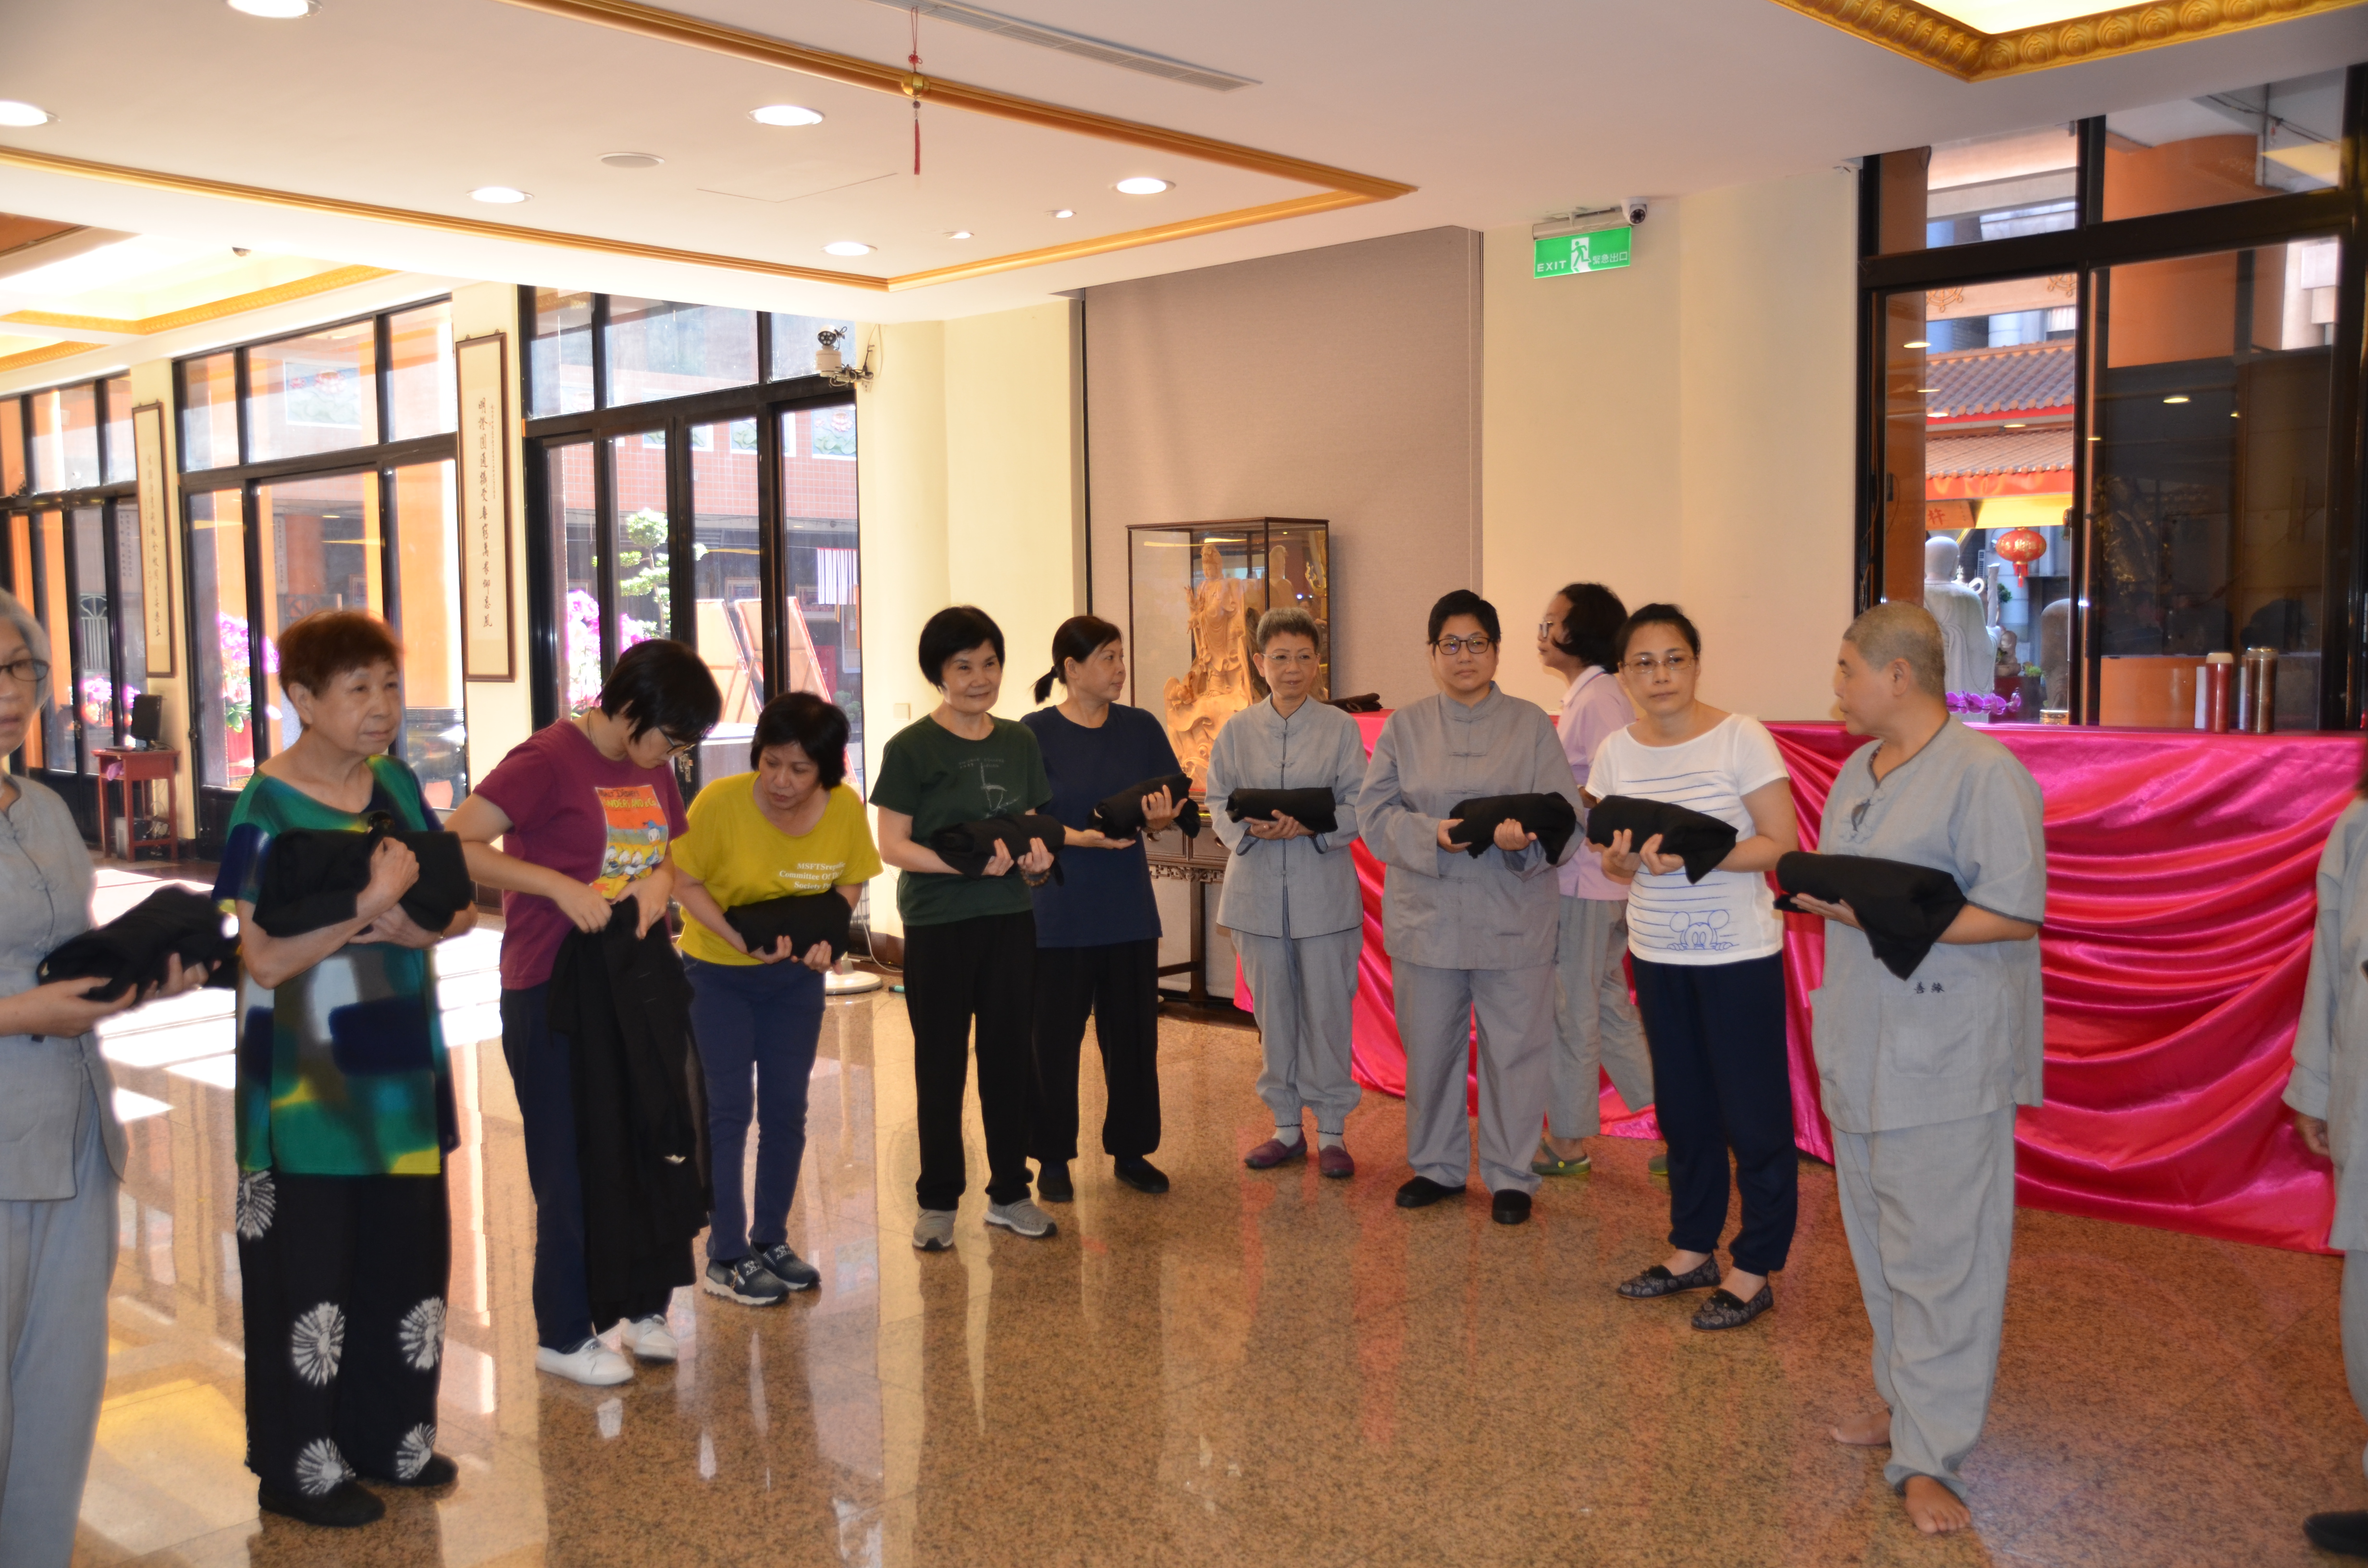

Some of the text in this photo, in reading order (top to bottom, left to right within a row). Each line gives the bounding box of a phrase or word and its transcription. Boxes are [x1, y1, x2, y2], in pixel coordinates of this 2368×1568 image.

[1592, 251, 1628, 265] 緊急出口
[1537, 260, 1567, 272] EXIT
[779, 870, 820, 881] Committee
[794, 881, 821, 890] Society
